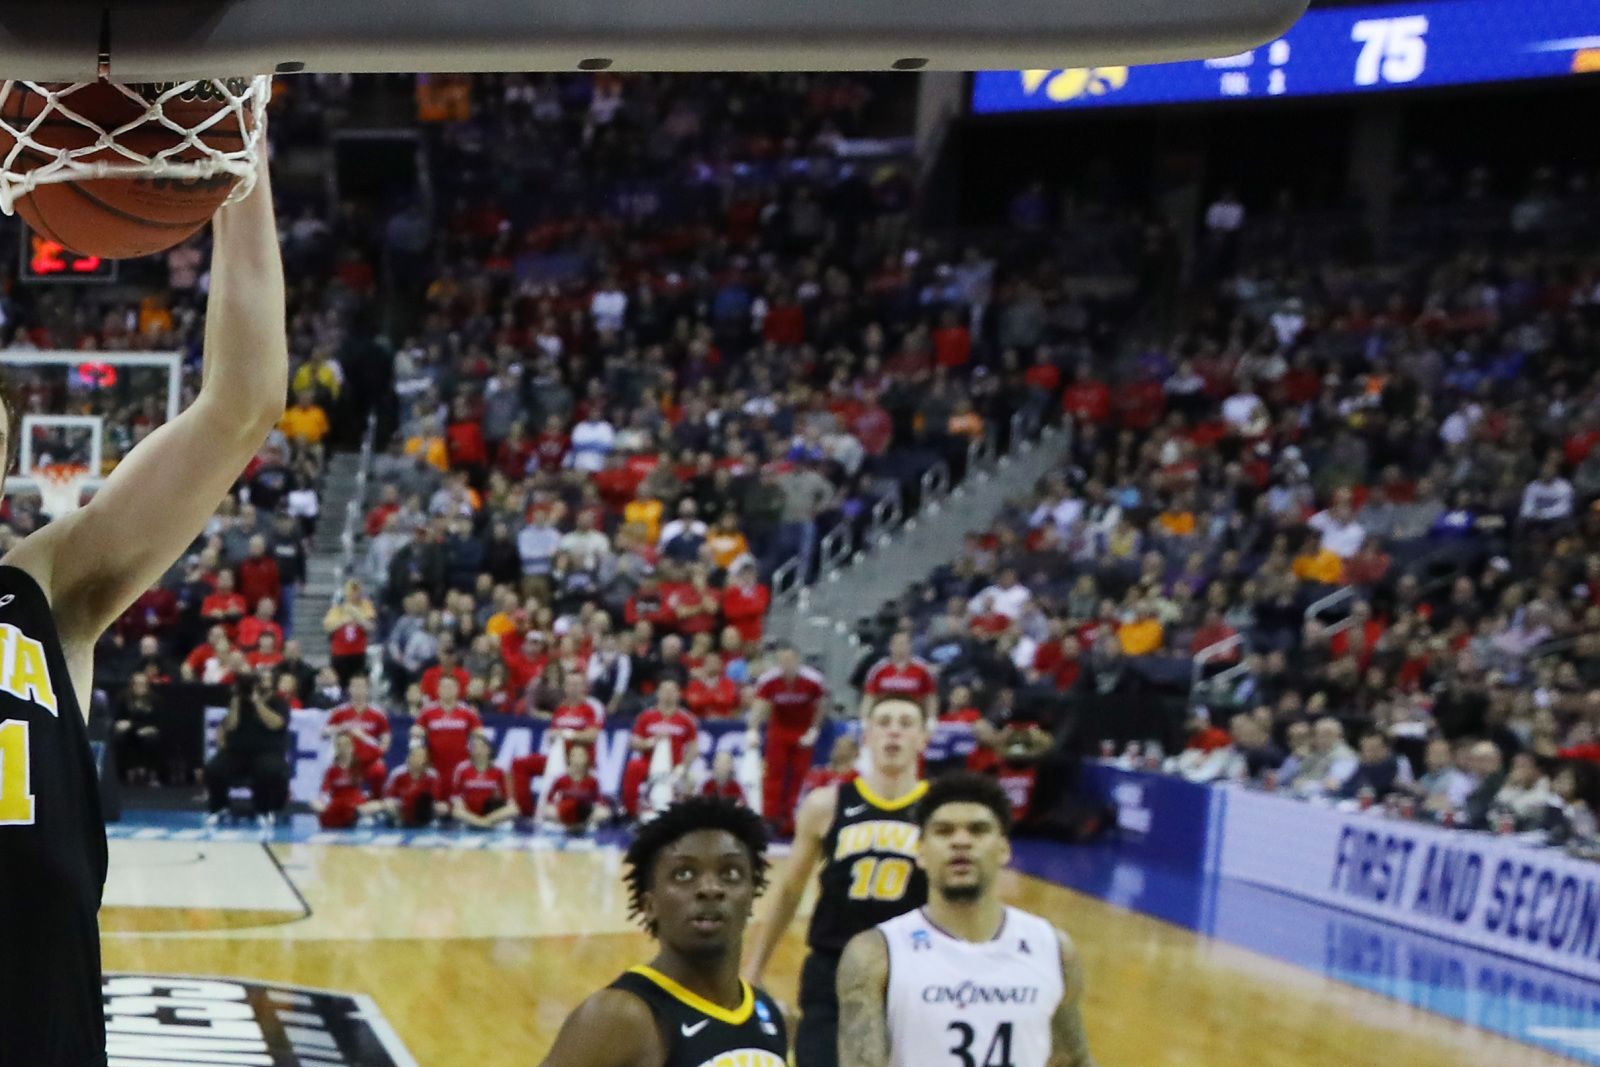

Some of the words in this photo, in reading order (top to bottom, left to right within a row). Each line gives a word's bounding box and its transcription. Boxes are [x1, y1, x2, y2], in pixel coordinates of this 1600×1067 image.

[1351, 15, 1428, 85] 75
[834, 820, 920, 861] IOW
[847, 856, 913, 900] 10
[1331, 825, 1415, 907] FIRST
[1412, 844, 1483, 925] AND
[922, 981, 1038, 1007] CINCINNATI
